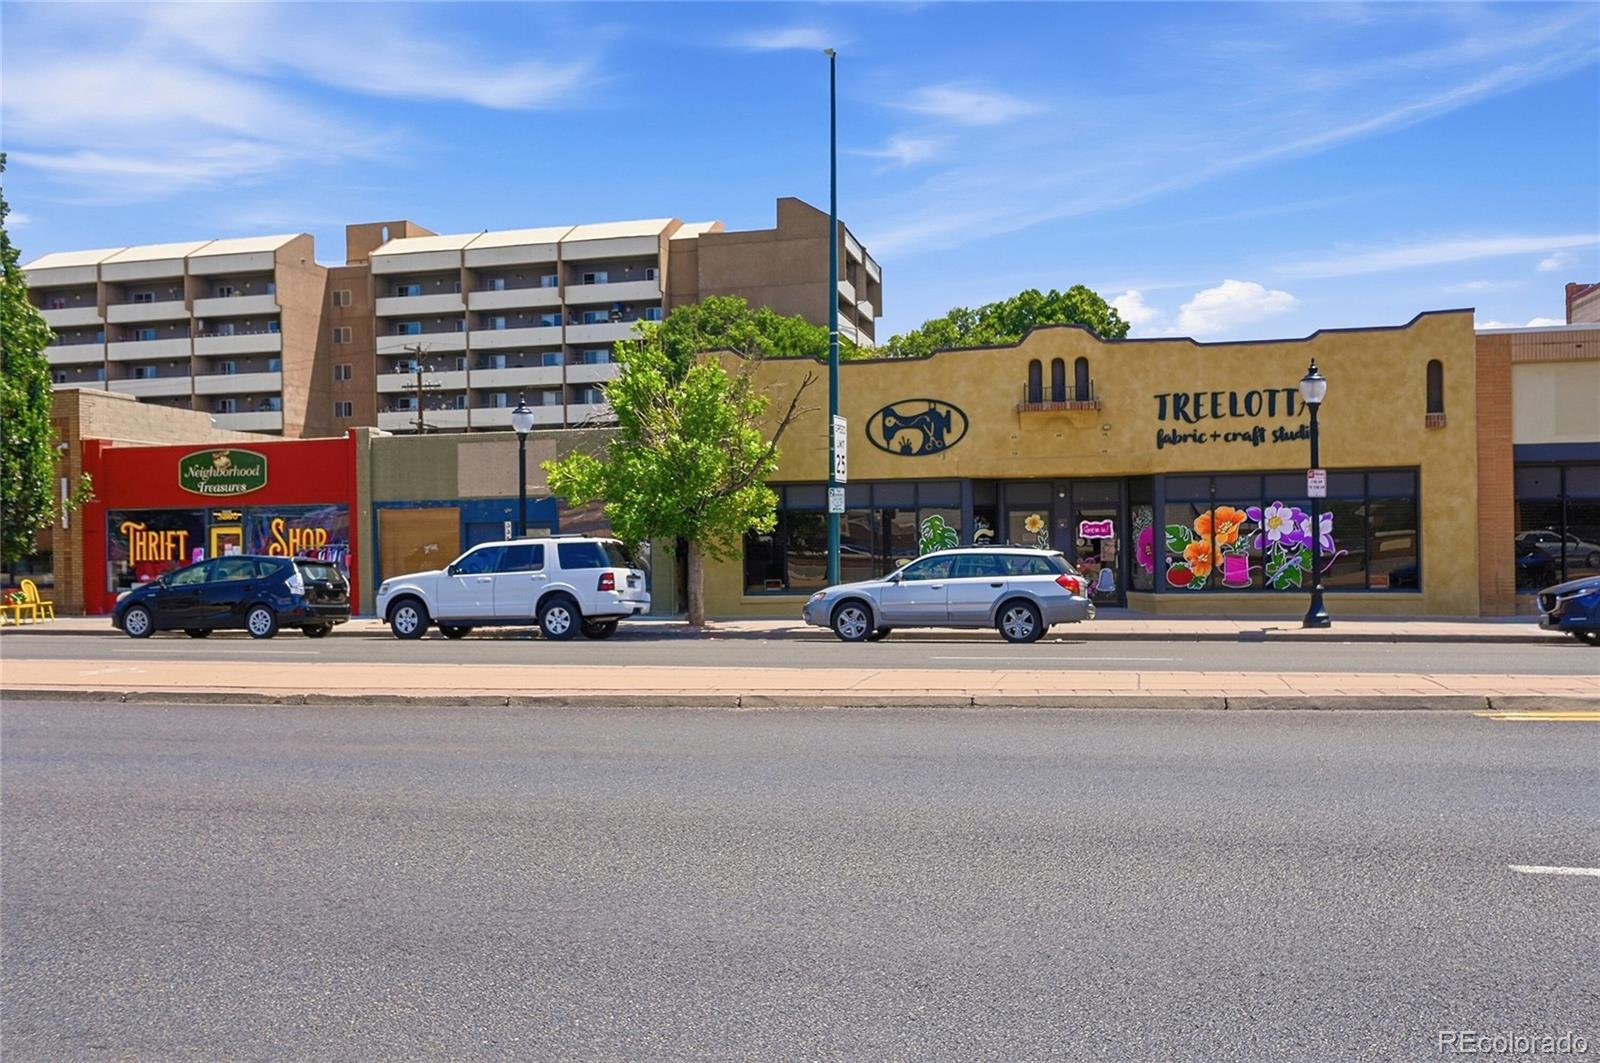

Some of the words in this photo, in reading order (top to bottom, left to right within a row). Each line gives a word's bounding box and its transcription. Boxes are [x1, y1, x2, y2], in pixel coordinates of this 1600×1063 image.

[1156, 428, 1208, 449] fabric
[1209, 431, 1221, 442] +
[1223, 426, 1266, 447] craft
[1272, 424, 1311, 443] studi
[184, 464, 260, 481] Neighborhood
[836, 454, 846, 474] 25
[197, 481, 247, 493] Treasures
[120, 521, 189, 567] THRIFT
